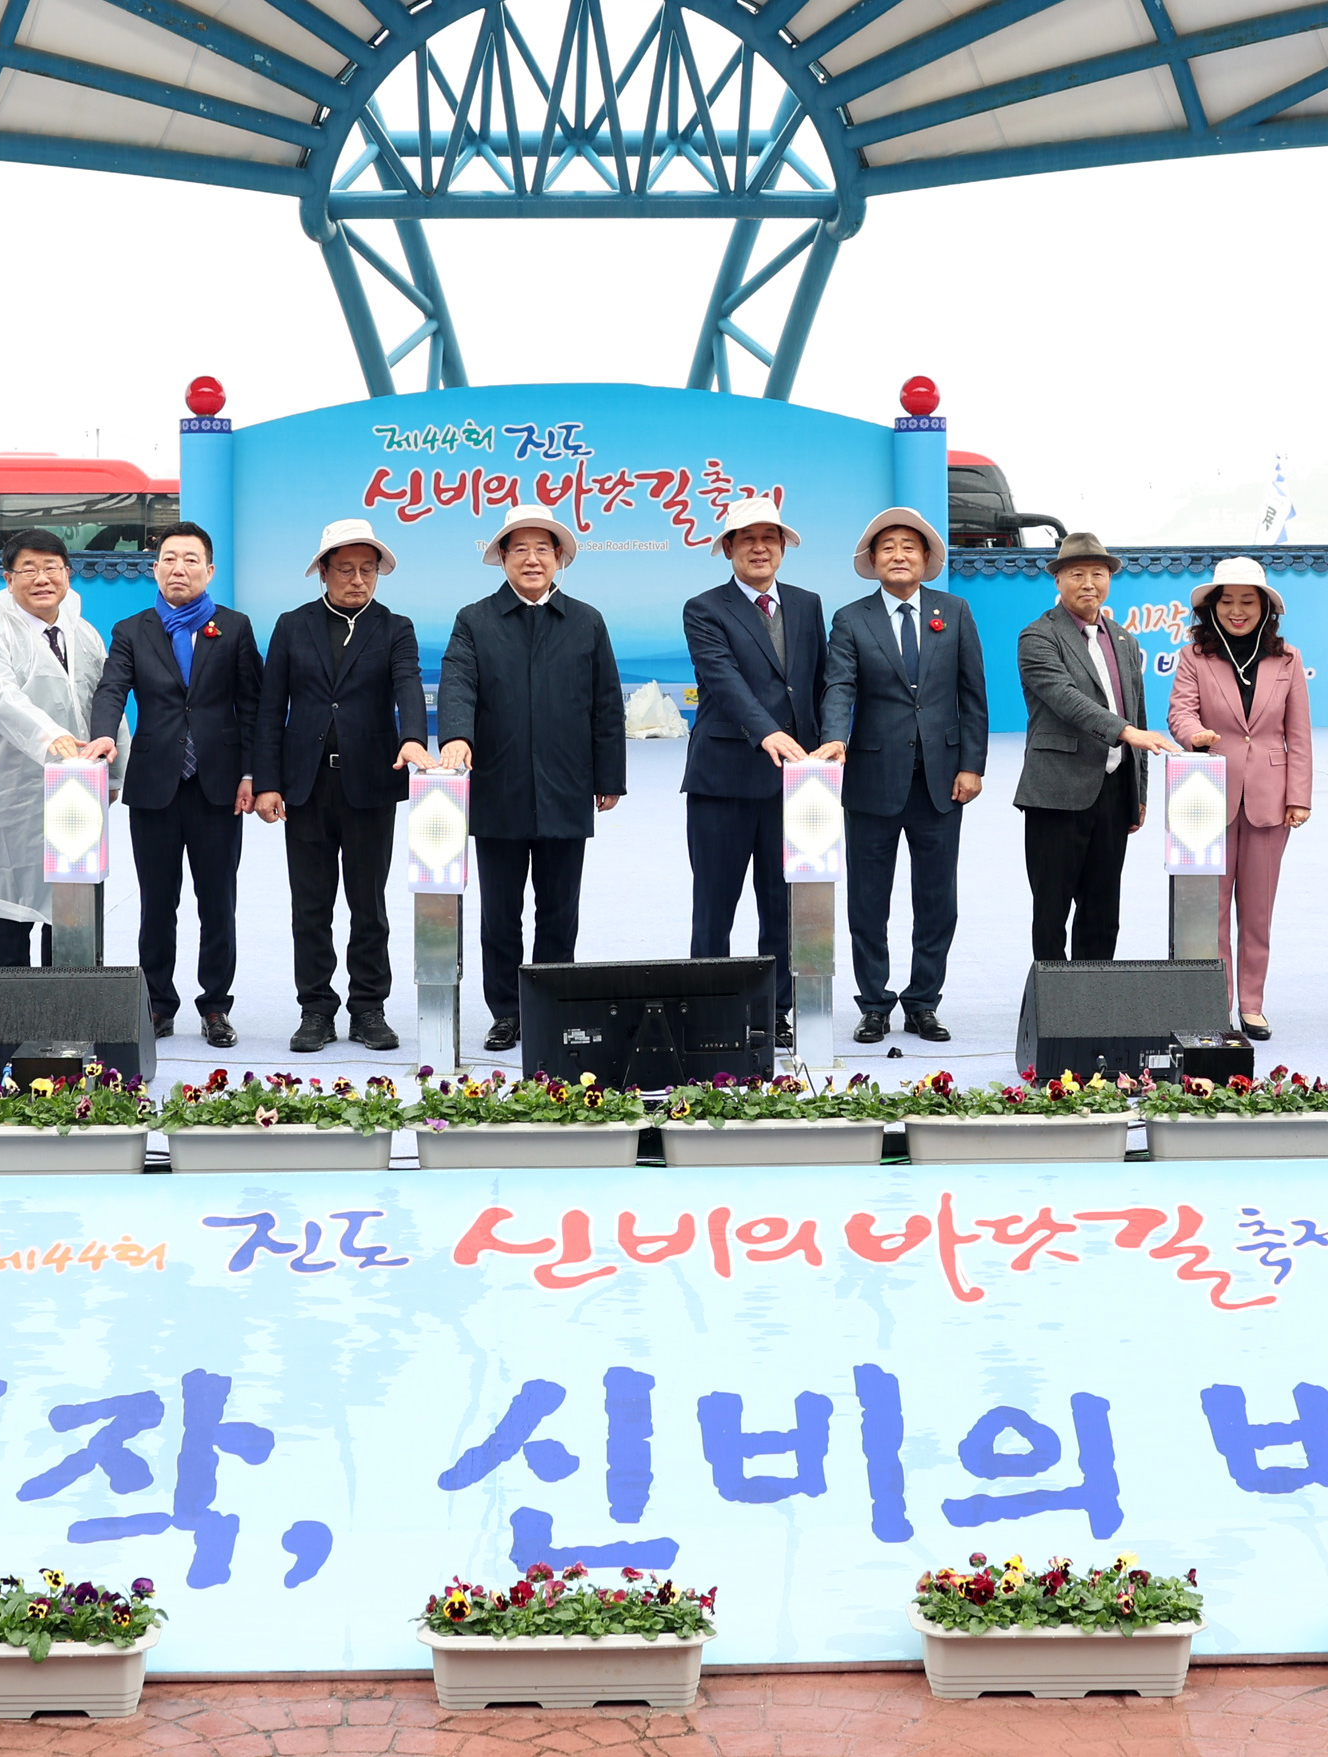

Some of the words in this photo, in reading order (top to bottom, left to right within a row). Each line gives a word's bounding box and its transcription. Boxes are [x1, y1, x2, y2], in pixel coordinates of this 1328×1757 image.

[374, 420, 494, 452] 제44회
[503, 422, 593, 459] 진도
[364, 468, 519, 522] 신비의
[535, 459, 713, 547] 바닷길
[586, 541, 603, 551] Sea
[606, 541, 630, 551] Road
[632, 541, 668, 551] Festival
[202, 1211, 411, 1273] 진도
[453, 1206, 823, 1290] 신비의
[844, 1192, 1277, 1311] 바닷길
[438, 1362, 1125, 1574] 신비의
